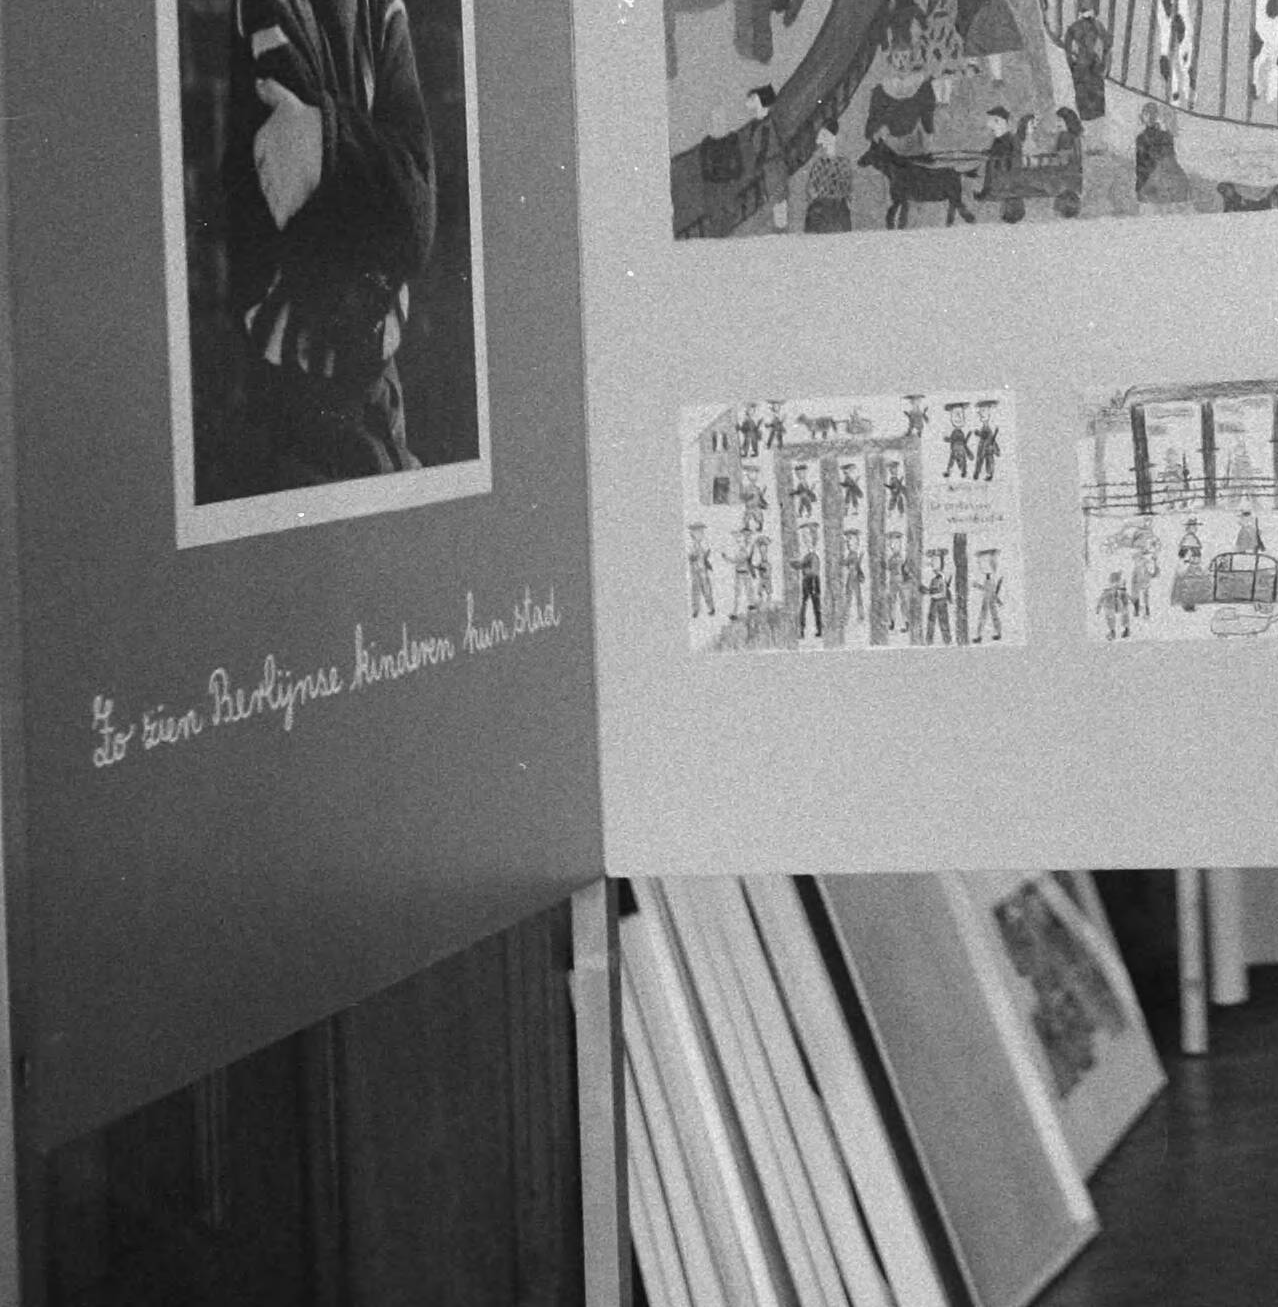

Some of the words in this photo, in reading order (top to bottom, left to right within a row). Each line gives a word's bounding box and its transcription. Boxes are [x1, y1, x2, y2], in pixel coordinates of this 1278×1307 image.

[93, 695, 136, 767] Zo
[142, 705, 203, 750] zien
[209, 654, 342, 731] Berlijnse
[350, 623, 456, 691] kinderen
[463, 590, 509, 654] hun
[512, 584, 562, 640] stad
